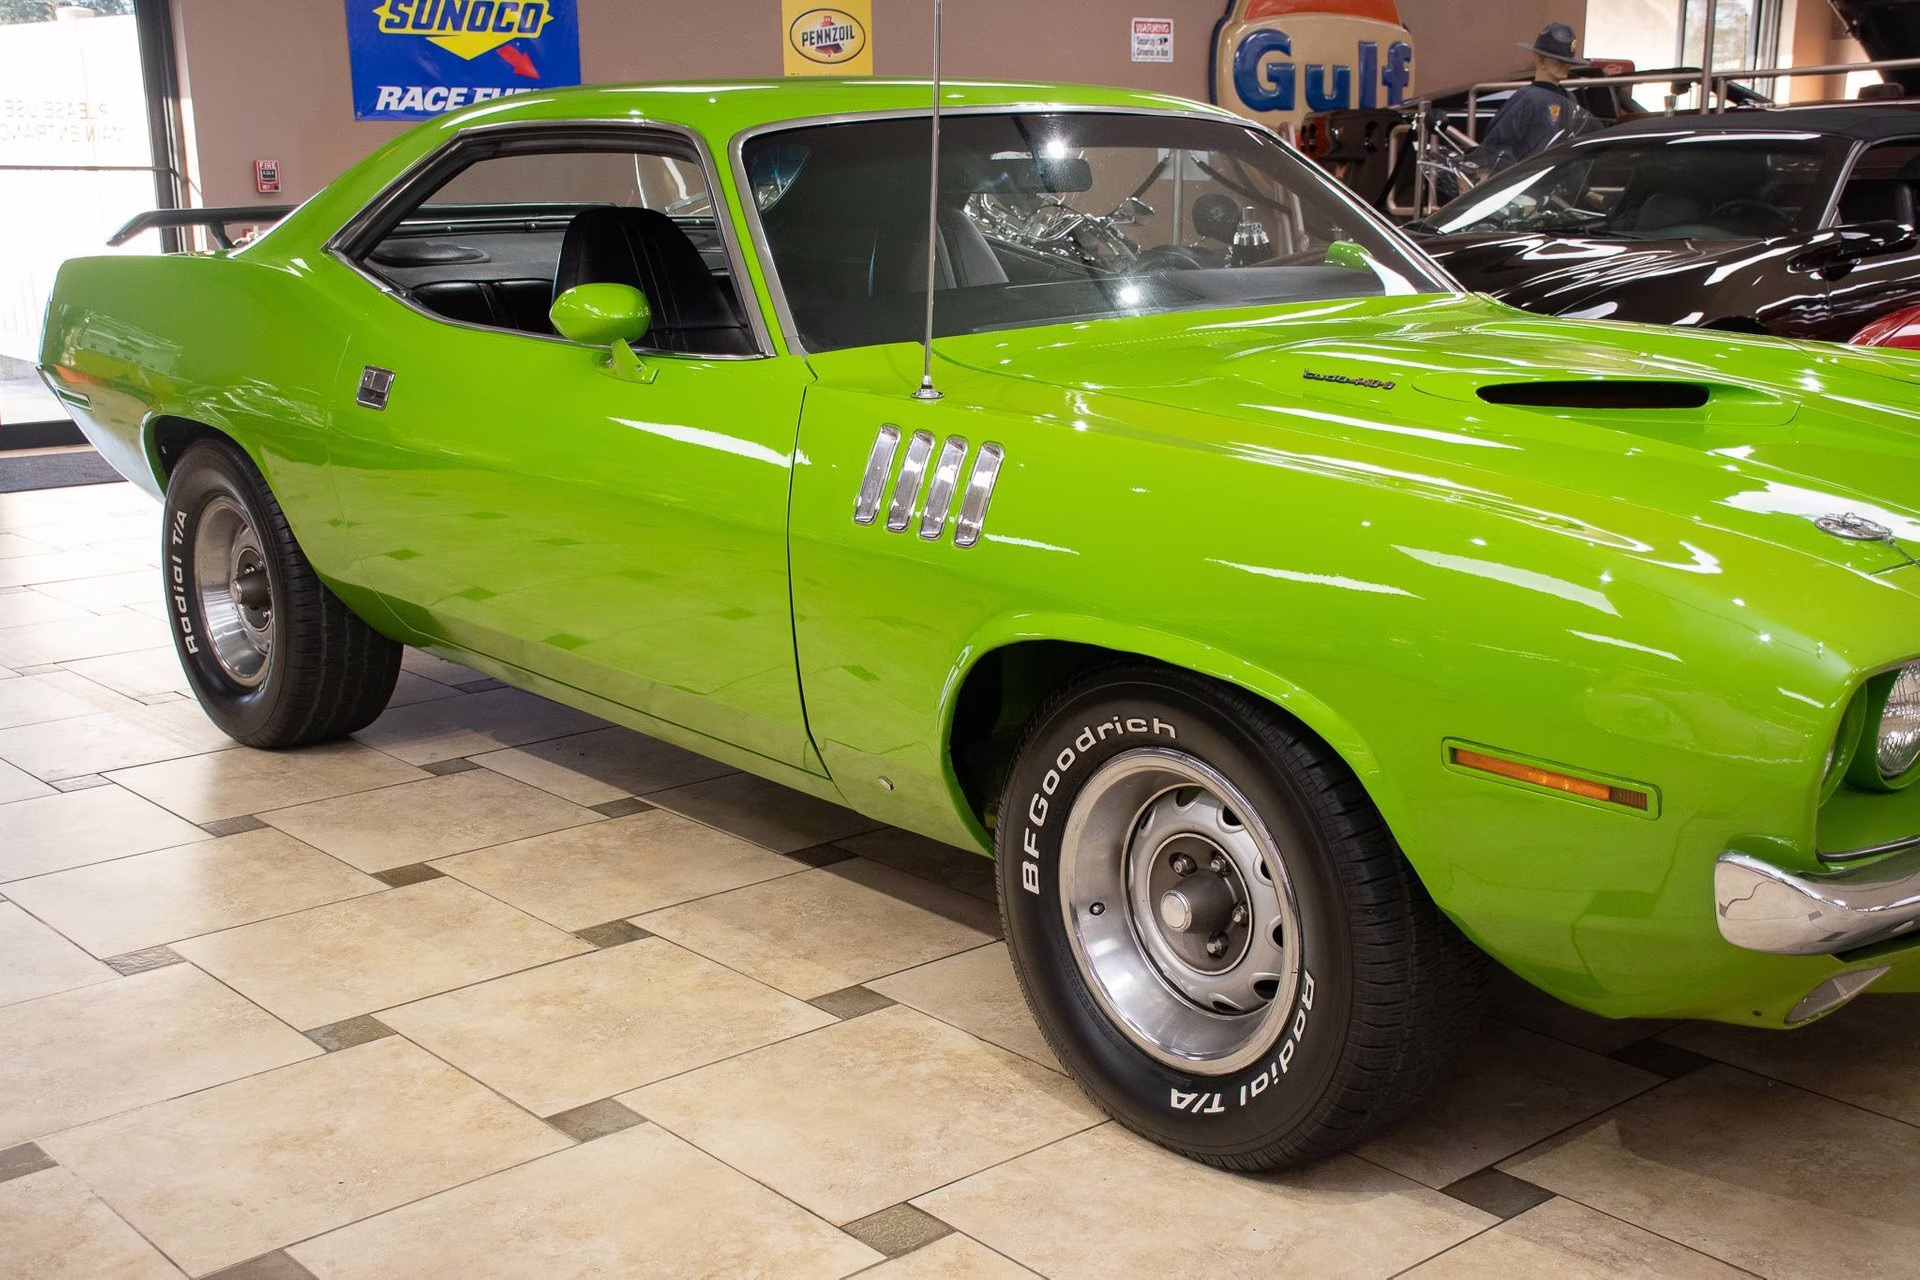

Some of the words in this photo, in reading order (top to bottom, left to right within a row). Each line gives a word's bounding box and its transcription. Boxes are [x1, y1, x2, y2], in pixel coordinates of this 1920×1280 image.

[384, 0, 545, 33] SUNOCO
[1136, 23, 1169, 33] WARNING
[801, 24, 855, 47] PENNZOIL
[1233, 28, 1412, 112] Gulf
[375, 86, 468, 111] RACE
[259, 161, 277, 170] FIRE
[172, 510, 187, 545] T/A
[172, 555, 199, 654] Radial
[1021, 715, 1177, 895] BFGoodrich
[1239, 968, 1316, 1107] Radial
[1170, 1088, 1226, 1114] T/A
